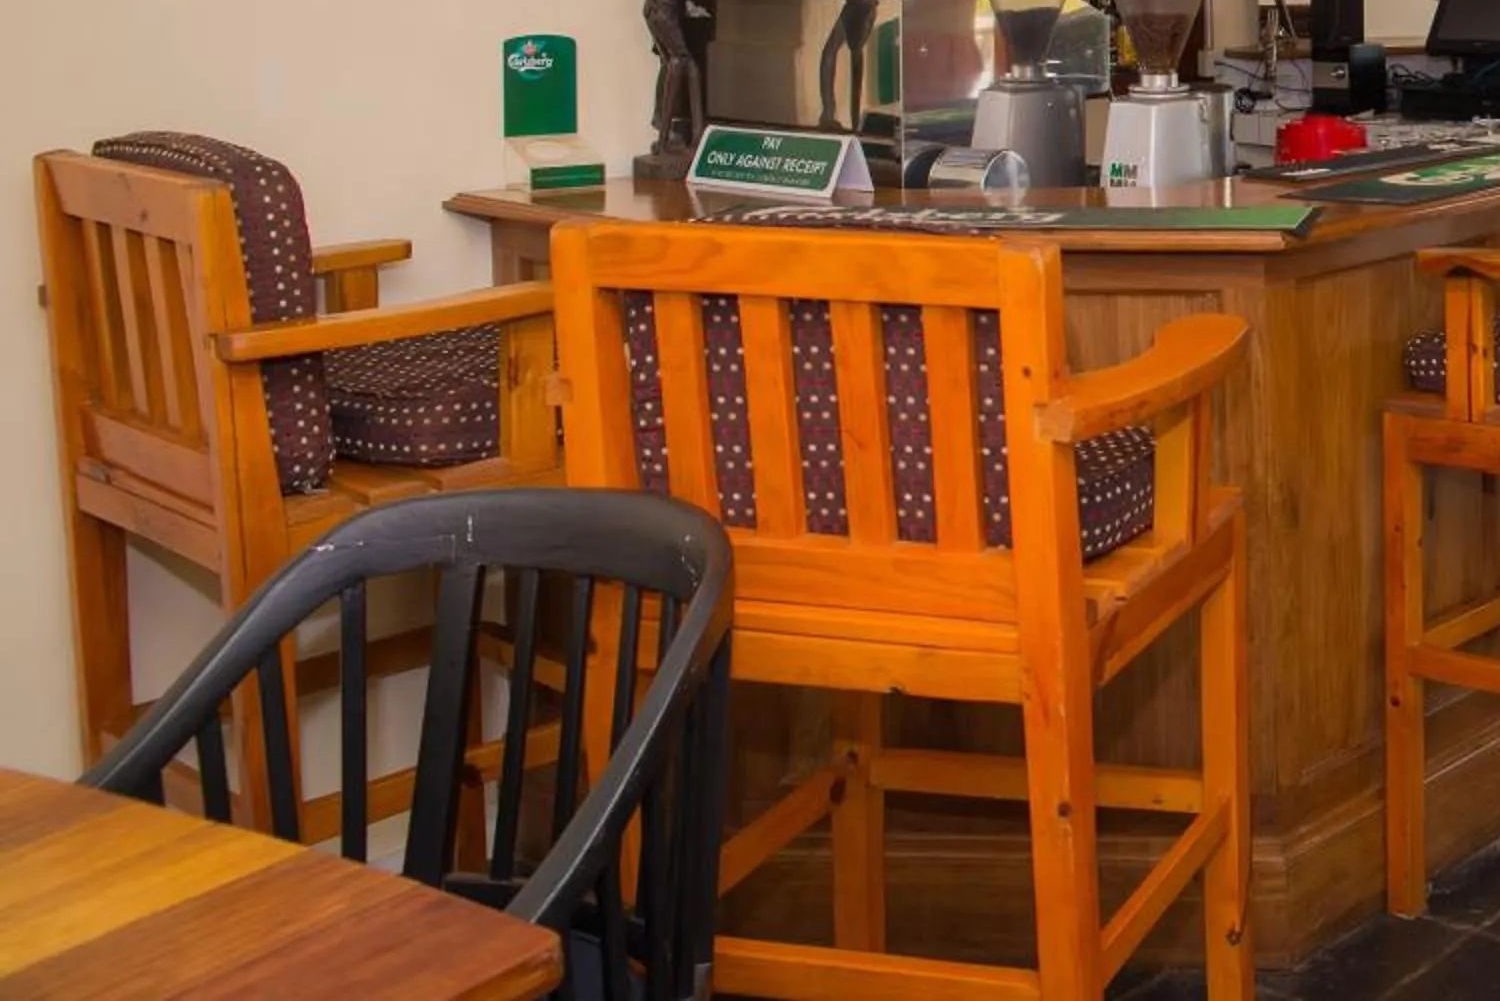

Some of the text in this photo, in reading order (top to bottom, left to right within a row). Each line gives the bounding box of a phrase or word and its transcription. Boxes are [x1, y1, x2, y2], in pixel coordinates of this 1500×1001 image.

[761, 136, 783, 150] PAY
[707, 150, 828, 176] ONLY AGAINST RECEIPT
